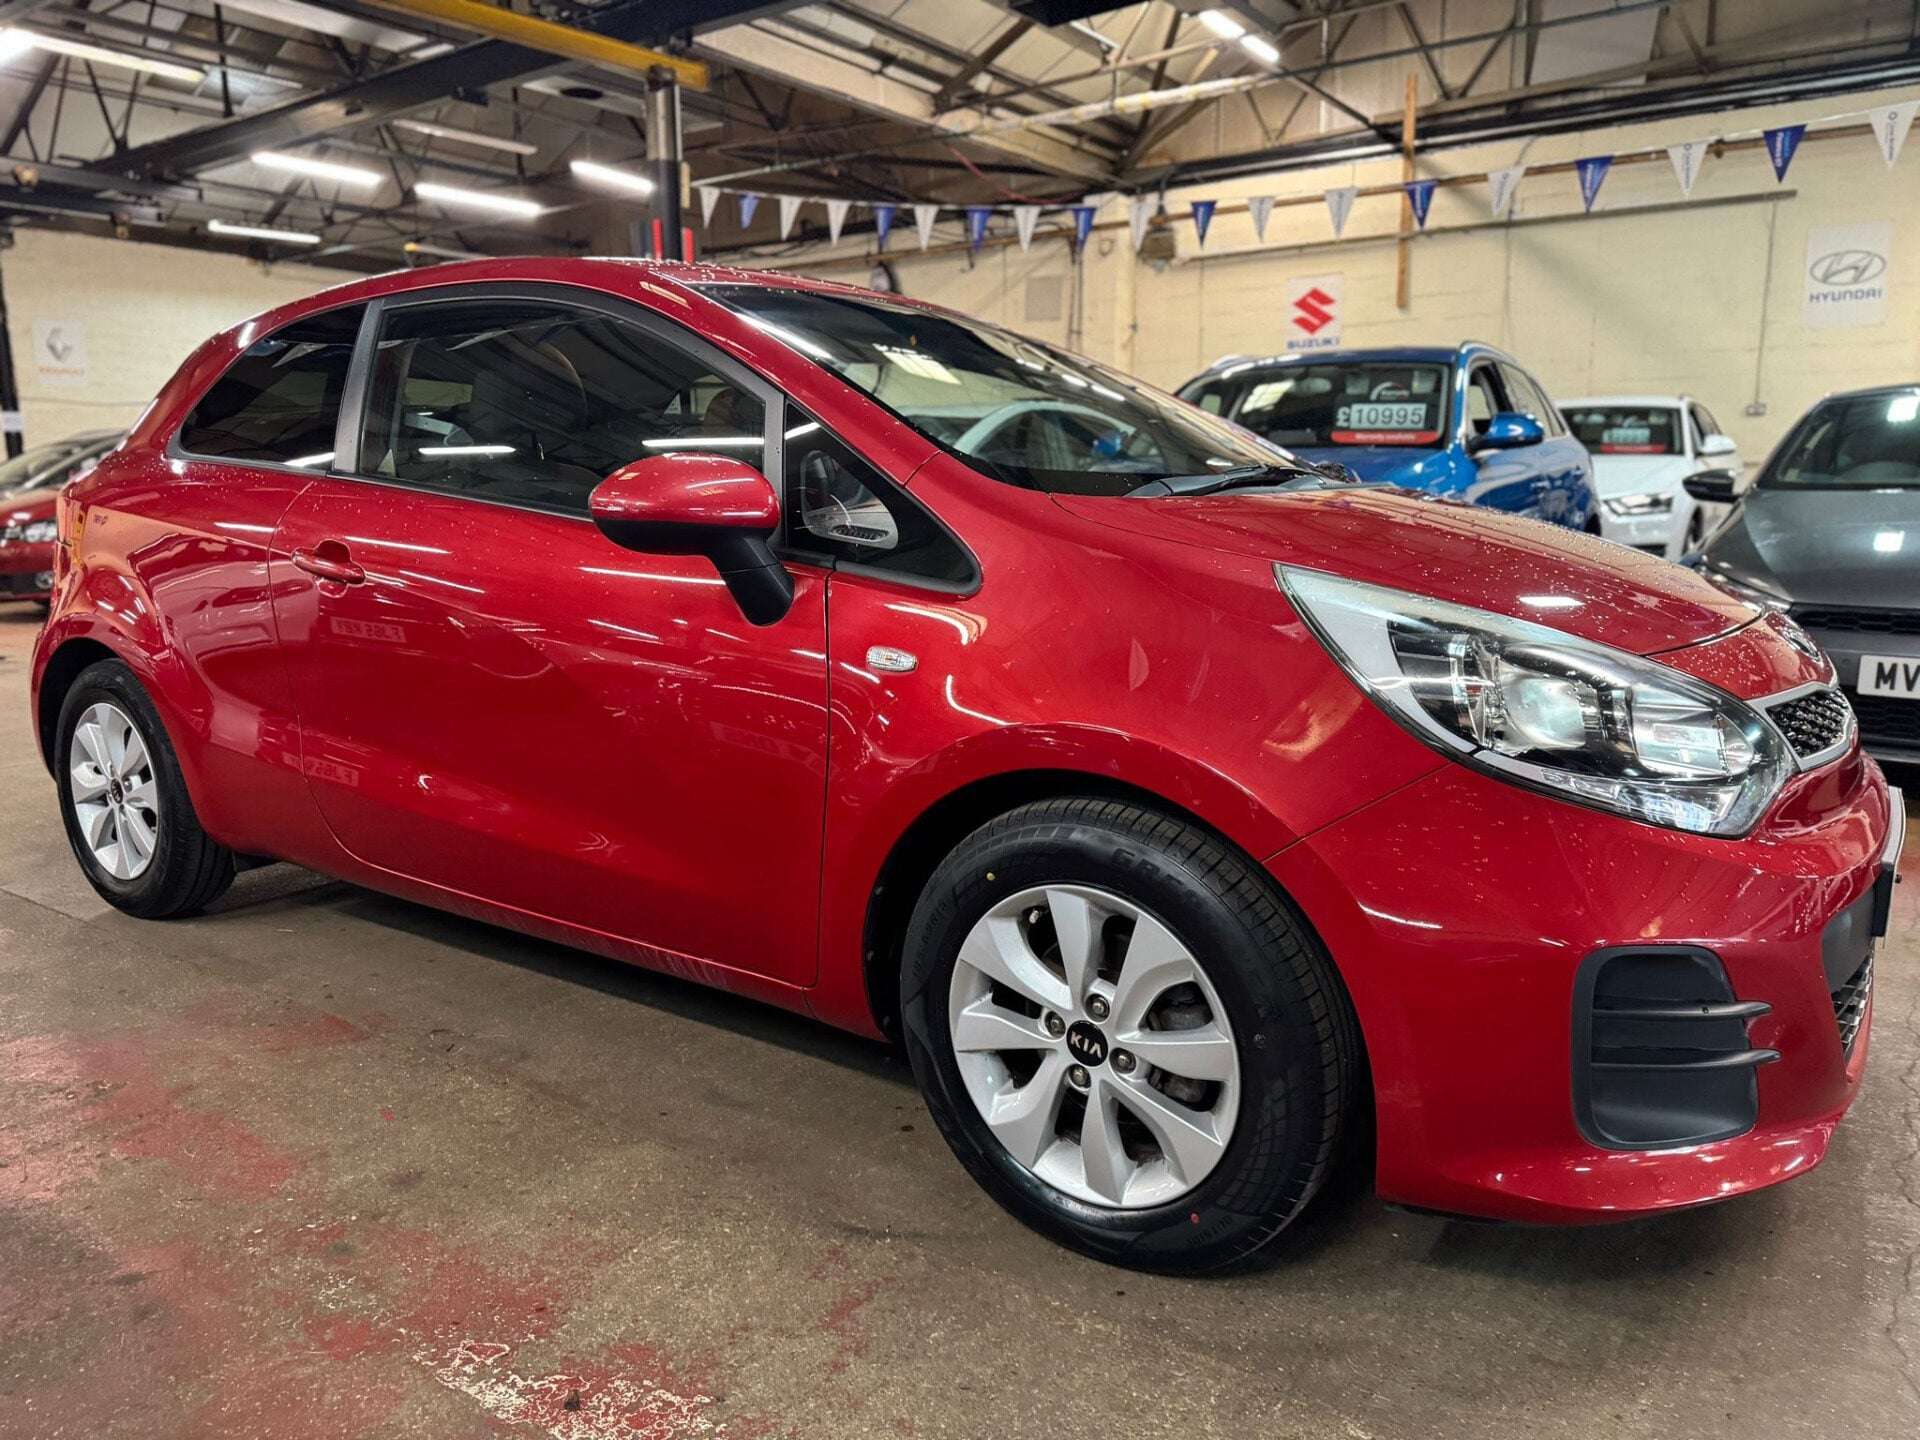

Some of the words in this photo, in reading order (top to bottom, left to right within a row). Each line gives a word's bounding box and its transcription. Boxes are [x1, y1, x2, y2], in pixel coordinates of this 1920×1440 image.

[1809, 288, 1882, 303] HYUNDAI
[1336, 406, 1422, 427] £10995
[1070, 1030, 1102, 1059] KIA
